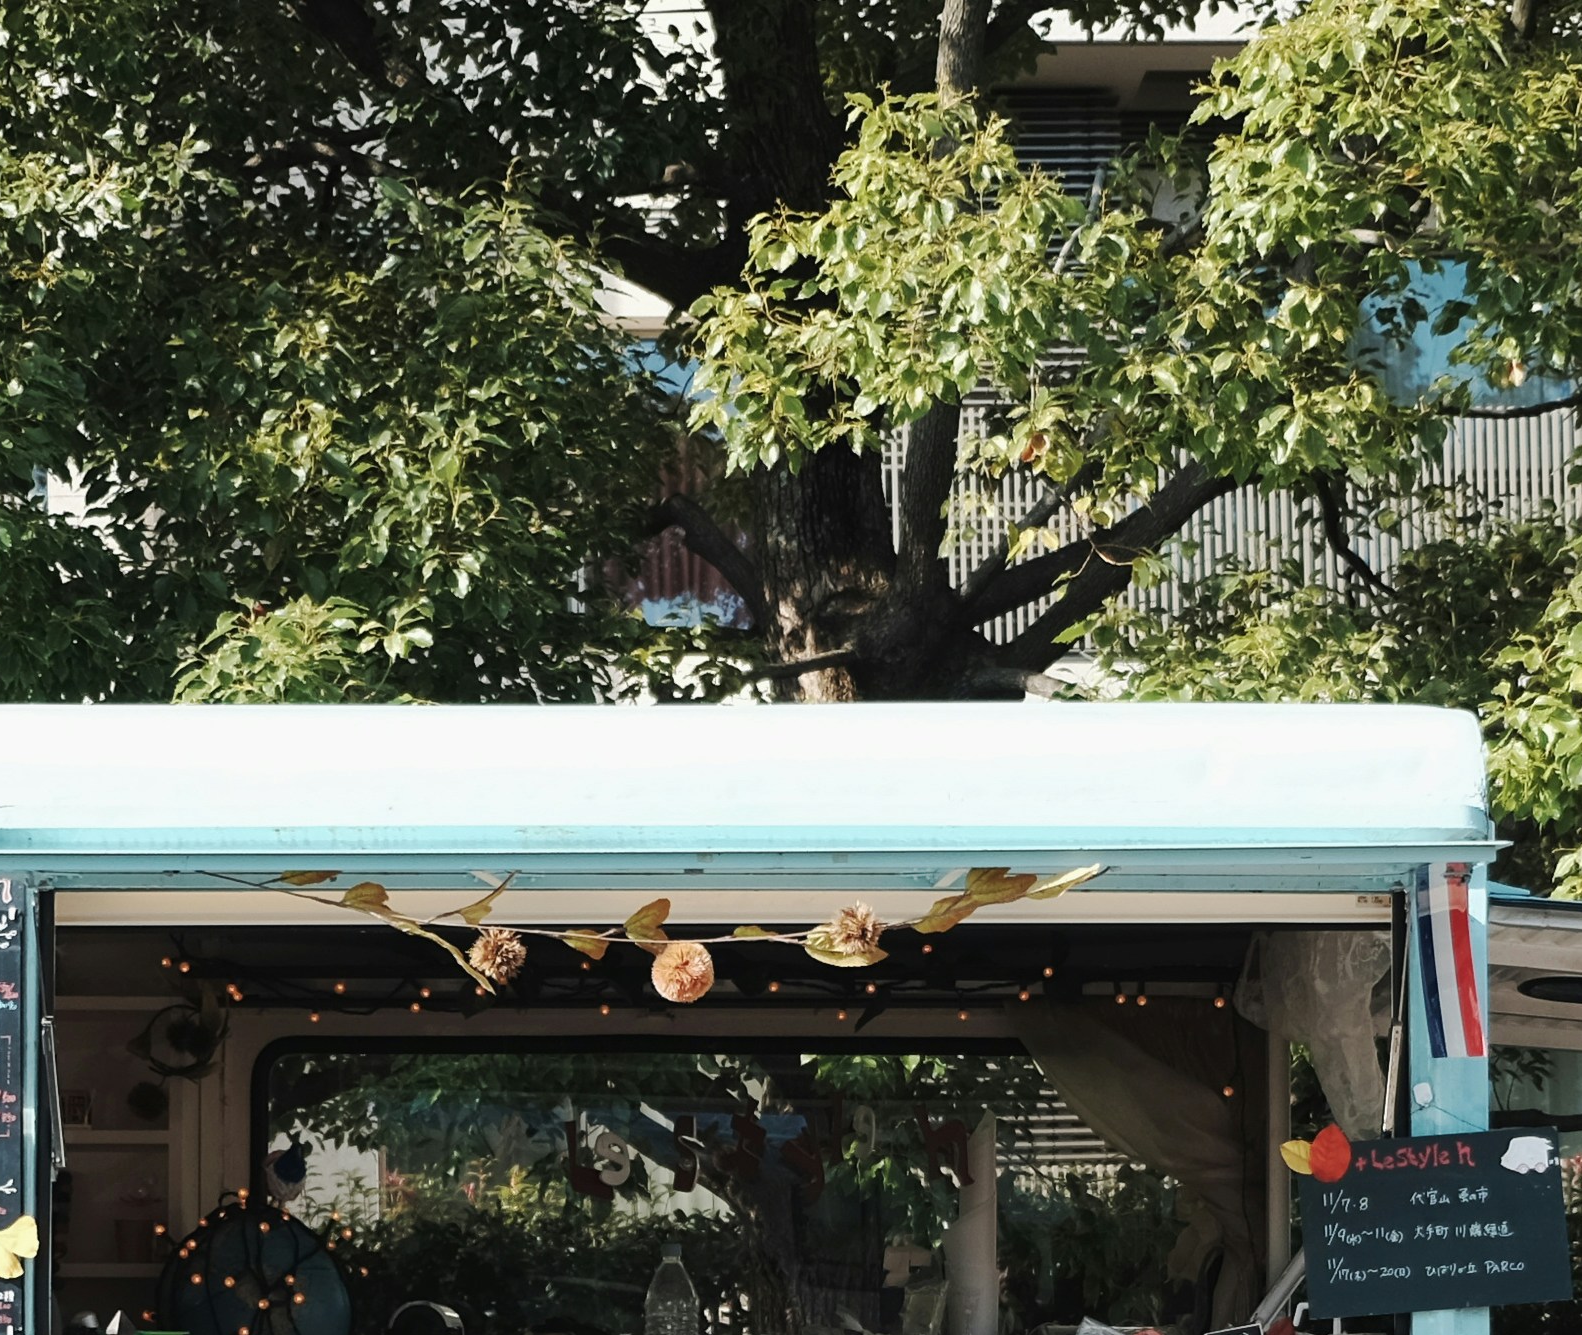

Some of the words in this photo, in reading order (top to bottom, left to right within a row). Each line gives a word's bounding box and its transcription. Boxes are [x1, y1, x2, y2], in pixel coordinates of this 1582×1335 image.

[1409, 1187, 1450, 1206] 代官山
[1413, 1224, 1449, 1241] 大手町
[1484, 1260, 1525, 1274] PARCO
